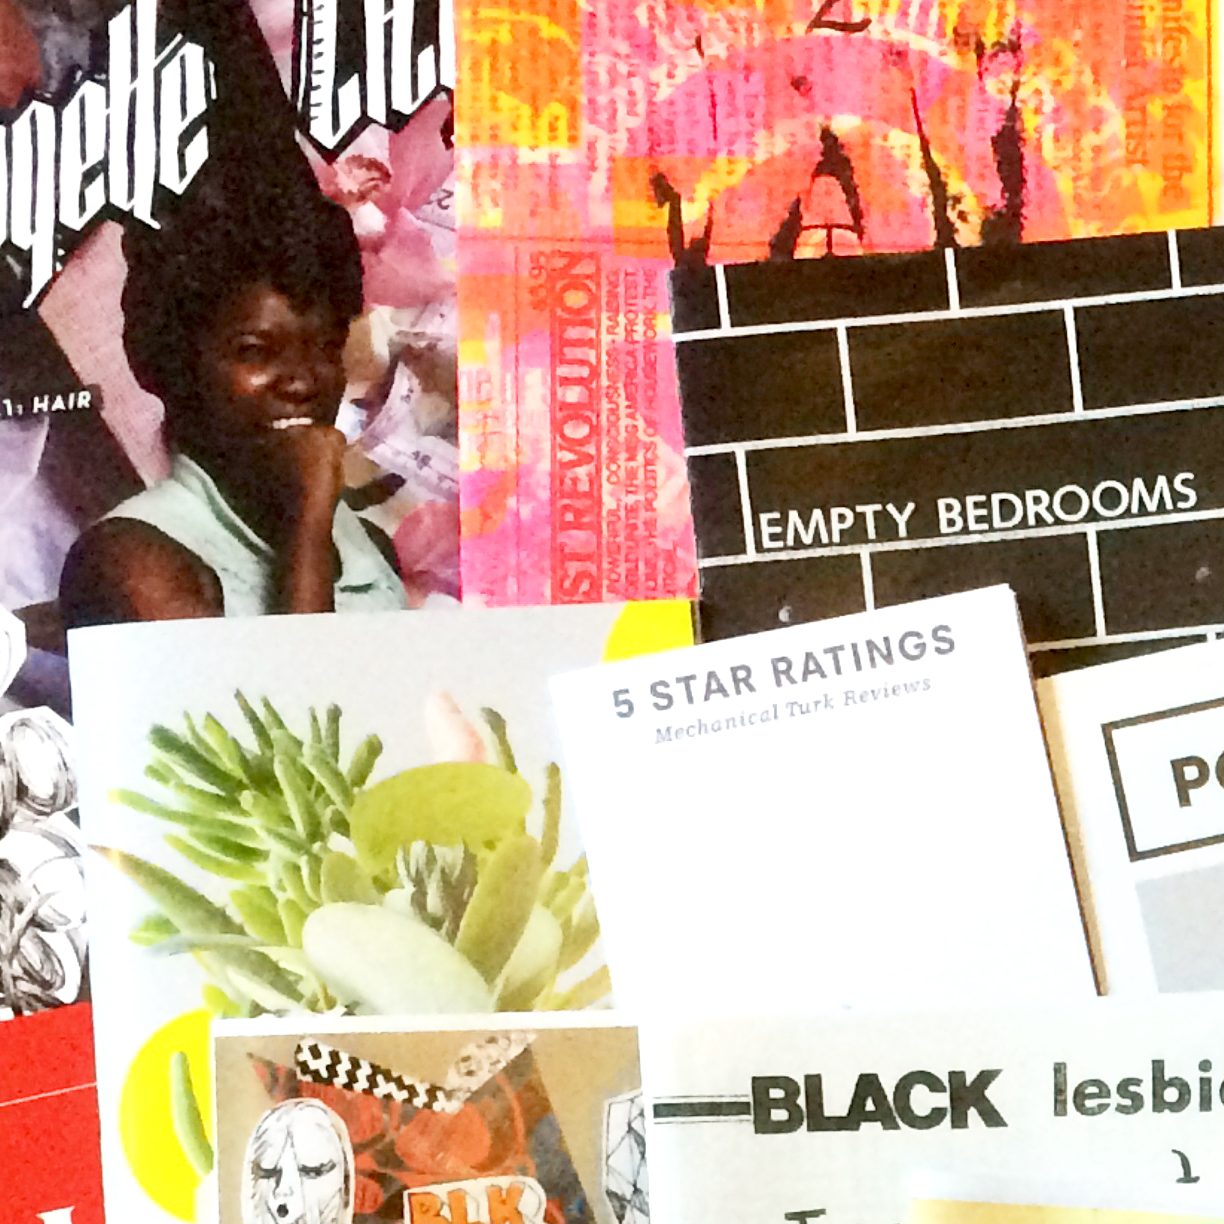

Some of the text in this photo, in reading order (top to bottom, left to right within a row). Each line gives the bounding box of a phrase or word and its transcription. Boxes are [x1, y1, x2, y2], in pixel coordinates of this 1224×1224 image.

[33, 390, 92, 414] HAIR
[557, 252, 597, 531] REVOLUTION
[760, 473, 1197, 551] EMPTY BEDROOMS
[612, 624, 956, 719] 5 STAR RATINGS
[655, 677, 932, 745] Mechanical Turk Reviews
[750, 1068, 1008, 1135] BLACK
